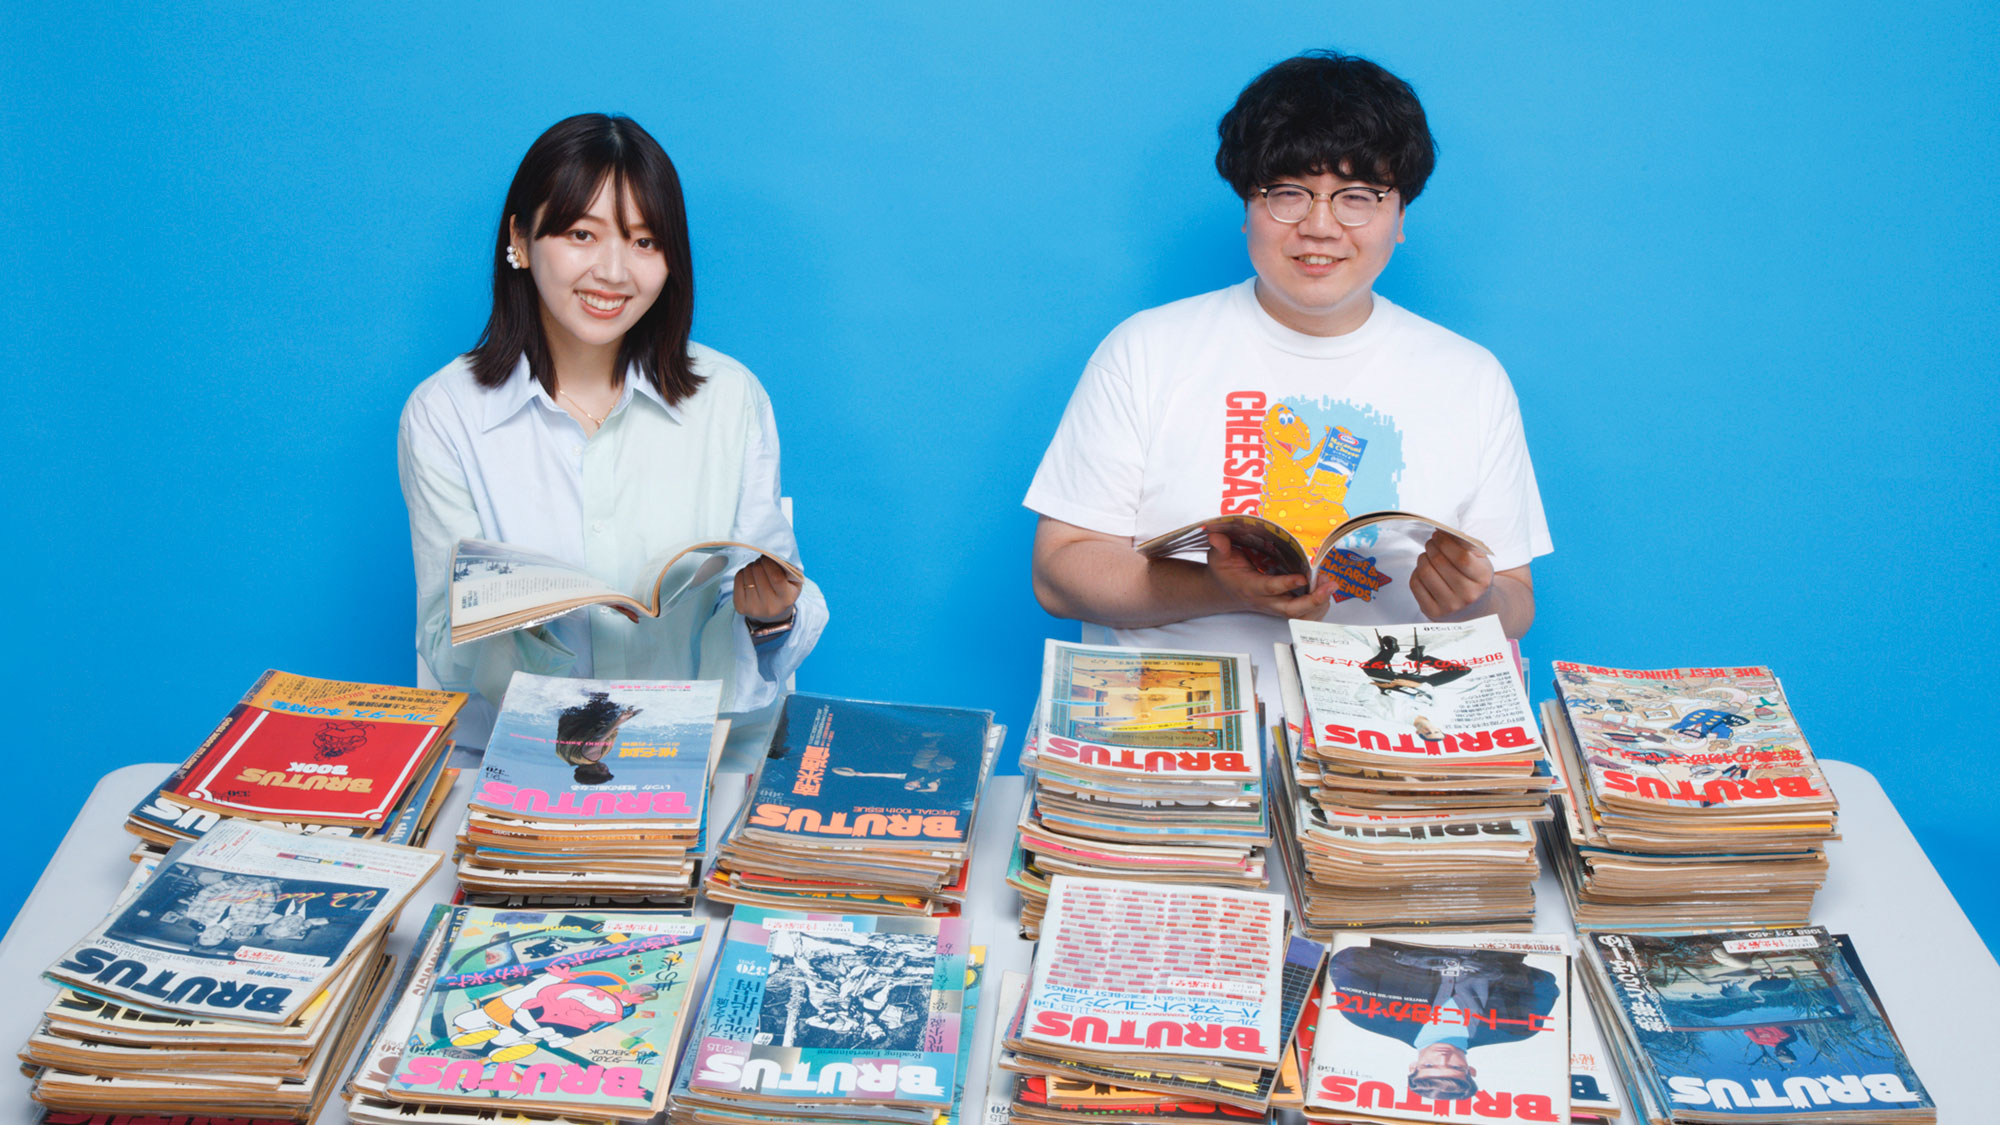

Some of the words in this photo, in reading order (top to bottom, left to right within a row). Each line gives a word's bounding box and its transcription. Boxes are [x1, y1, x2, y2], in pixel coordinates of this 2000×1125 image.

[1220, 390, 1267, 516] CHEESAS
[1623, 668, 1685, 681] THINGS
[1688, 667, 1730, 679] BEST
[1732, 667, 1765, 678] THE
[1323, 724, 1537, 756] BRUTUS
[1043, 735, 1253, 773] BRUTUS
[286, 761, 349, 776] BOOK
[235, 767, 374, 794] BRUTUS
[1602, 769, 1823, 805] BRUTUS
[475, 781, 693, 817] BRUTUS
[853, 806, 884, 814] ISSUE
[885, 807, 913, 815] 100th
[915, 808, 961, 817] SPECIAL
[749, 803, 963, 838] BRUTUS
[1775, 927, 1794, 937] 2/1
[1797, 927, 1823, 936] 1988
[735, 963, 767, 977] 370
[54, 947, 293, 1016] BRUTUS
[1043, 983, 1089, 997] THINGS
[1339, 986, 1378, 999] STYLEBOOK
[1043, 992, 1262, 1020] パーマネント・コレクション
[1092, 1008, 1139, 1016] COLLECTION
[1325, 991, 1556, 1033] コートに抱かれて
[1190, 1014, 1262, 1028] ブルータスの
[1028, 1010, 1269, 1056] BRUTUS
[590, 1055, 657, 1066] ブルータスの
[816, 1050, 881, 1059] Entertainment
[882, 1051, 922, 1060] Reading
[394, 1056, 647, 1100] BRUTUS
[697, 1053, 945, 1097] BRUTUS
[1668, 1072, 1922, 1110] BRUTUS
[1316, 1075, 1561, 1124] BRUTUS
